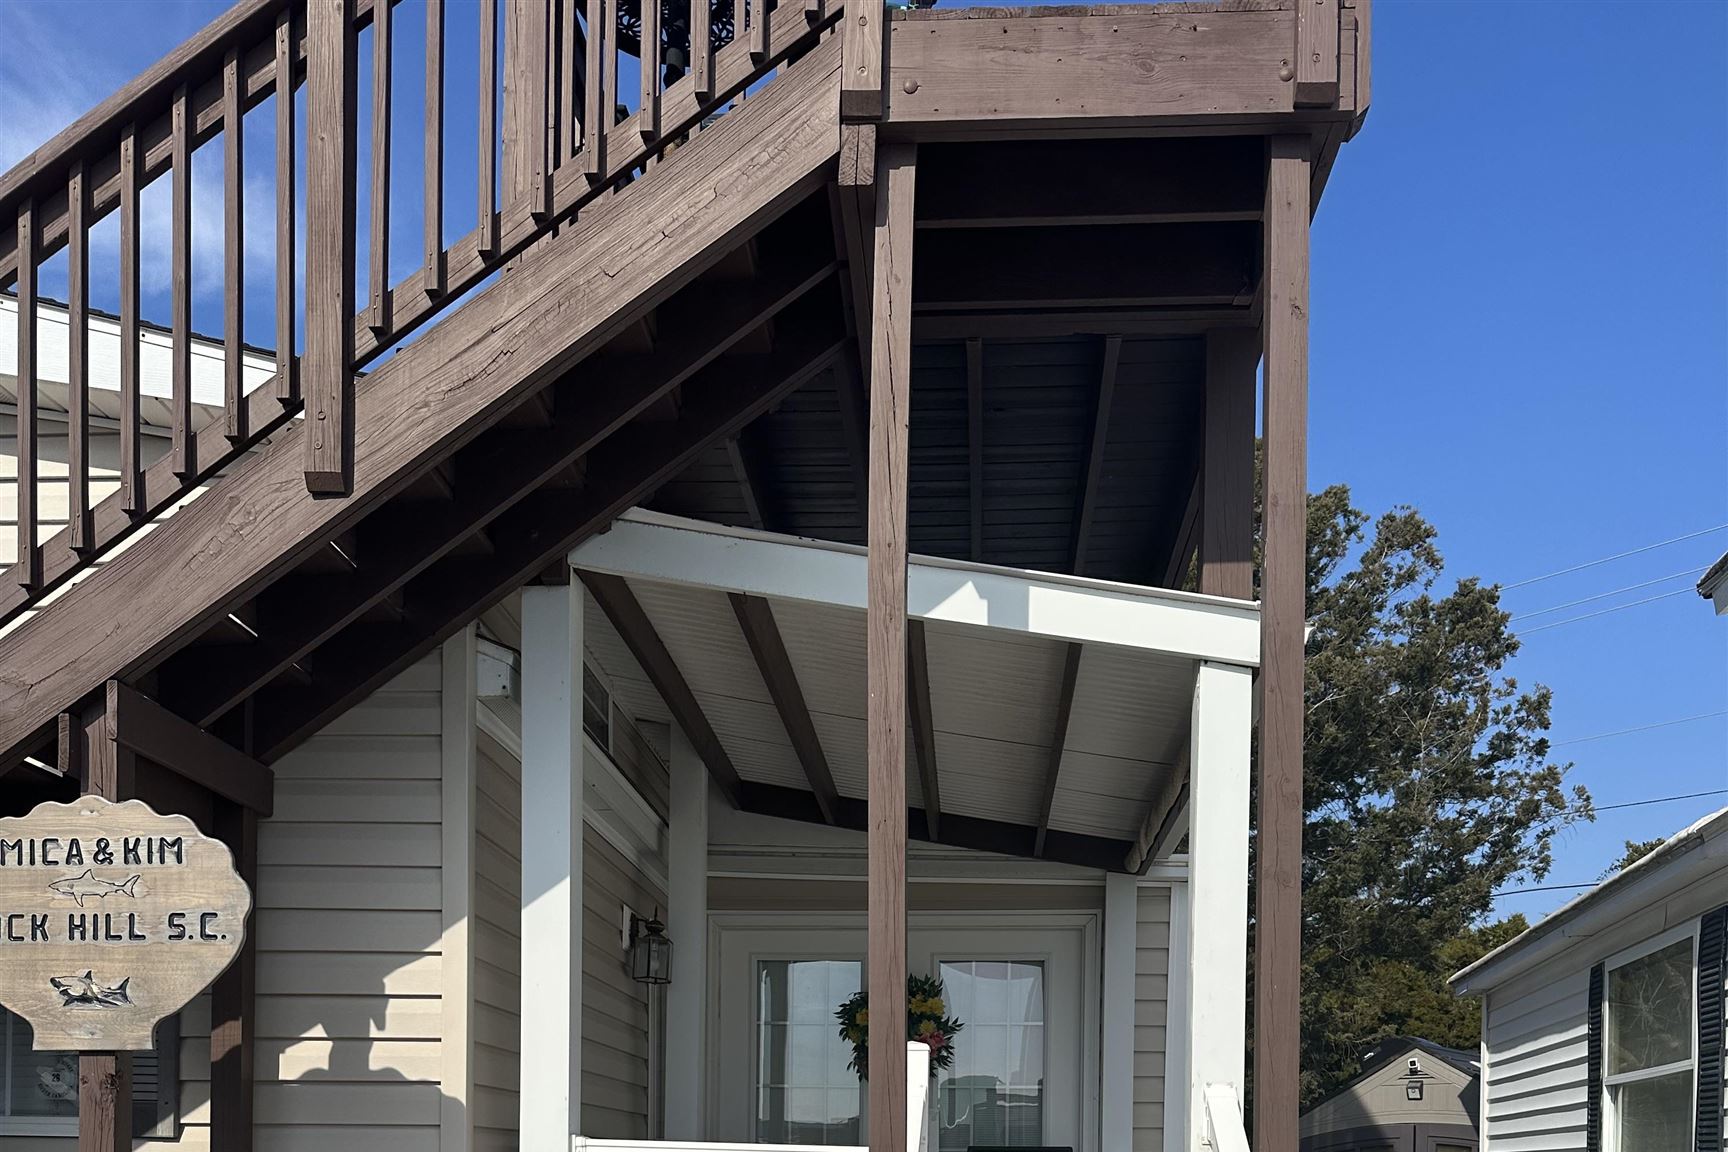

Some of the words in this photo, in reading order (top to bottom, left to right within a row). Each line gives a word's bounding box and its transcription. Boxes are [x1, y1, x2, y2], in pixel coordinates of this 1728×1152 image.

[123, 837, 183, 865] KIM
[0, 913, 49, 942] CK
[68, 913, 146, 941] HILL
[167, 912, 227, 941] S.C.
